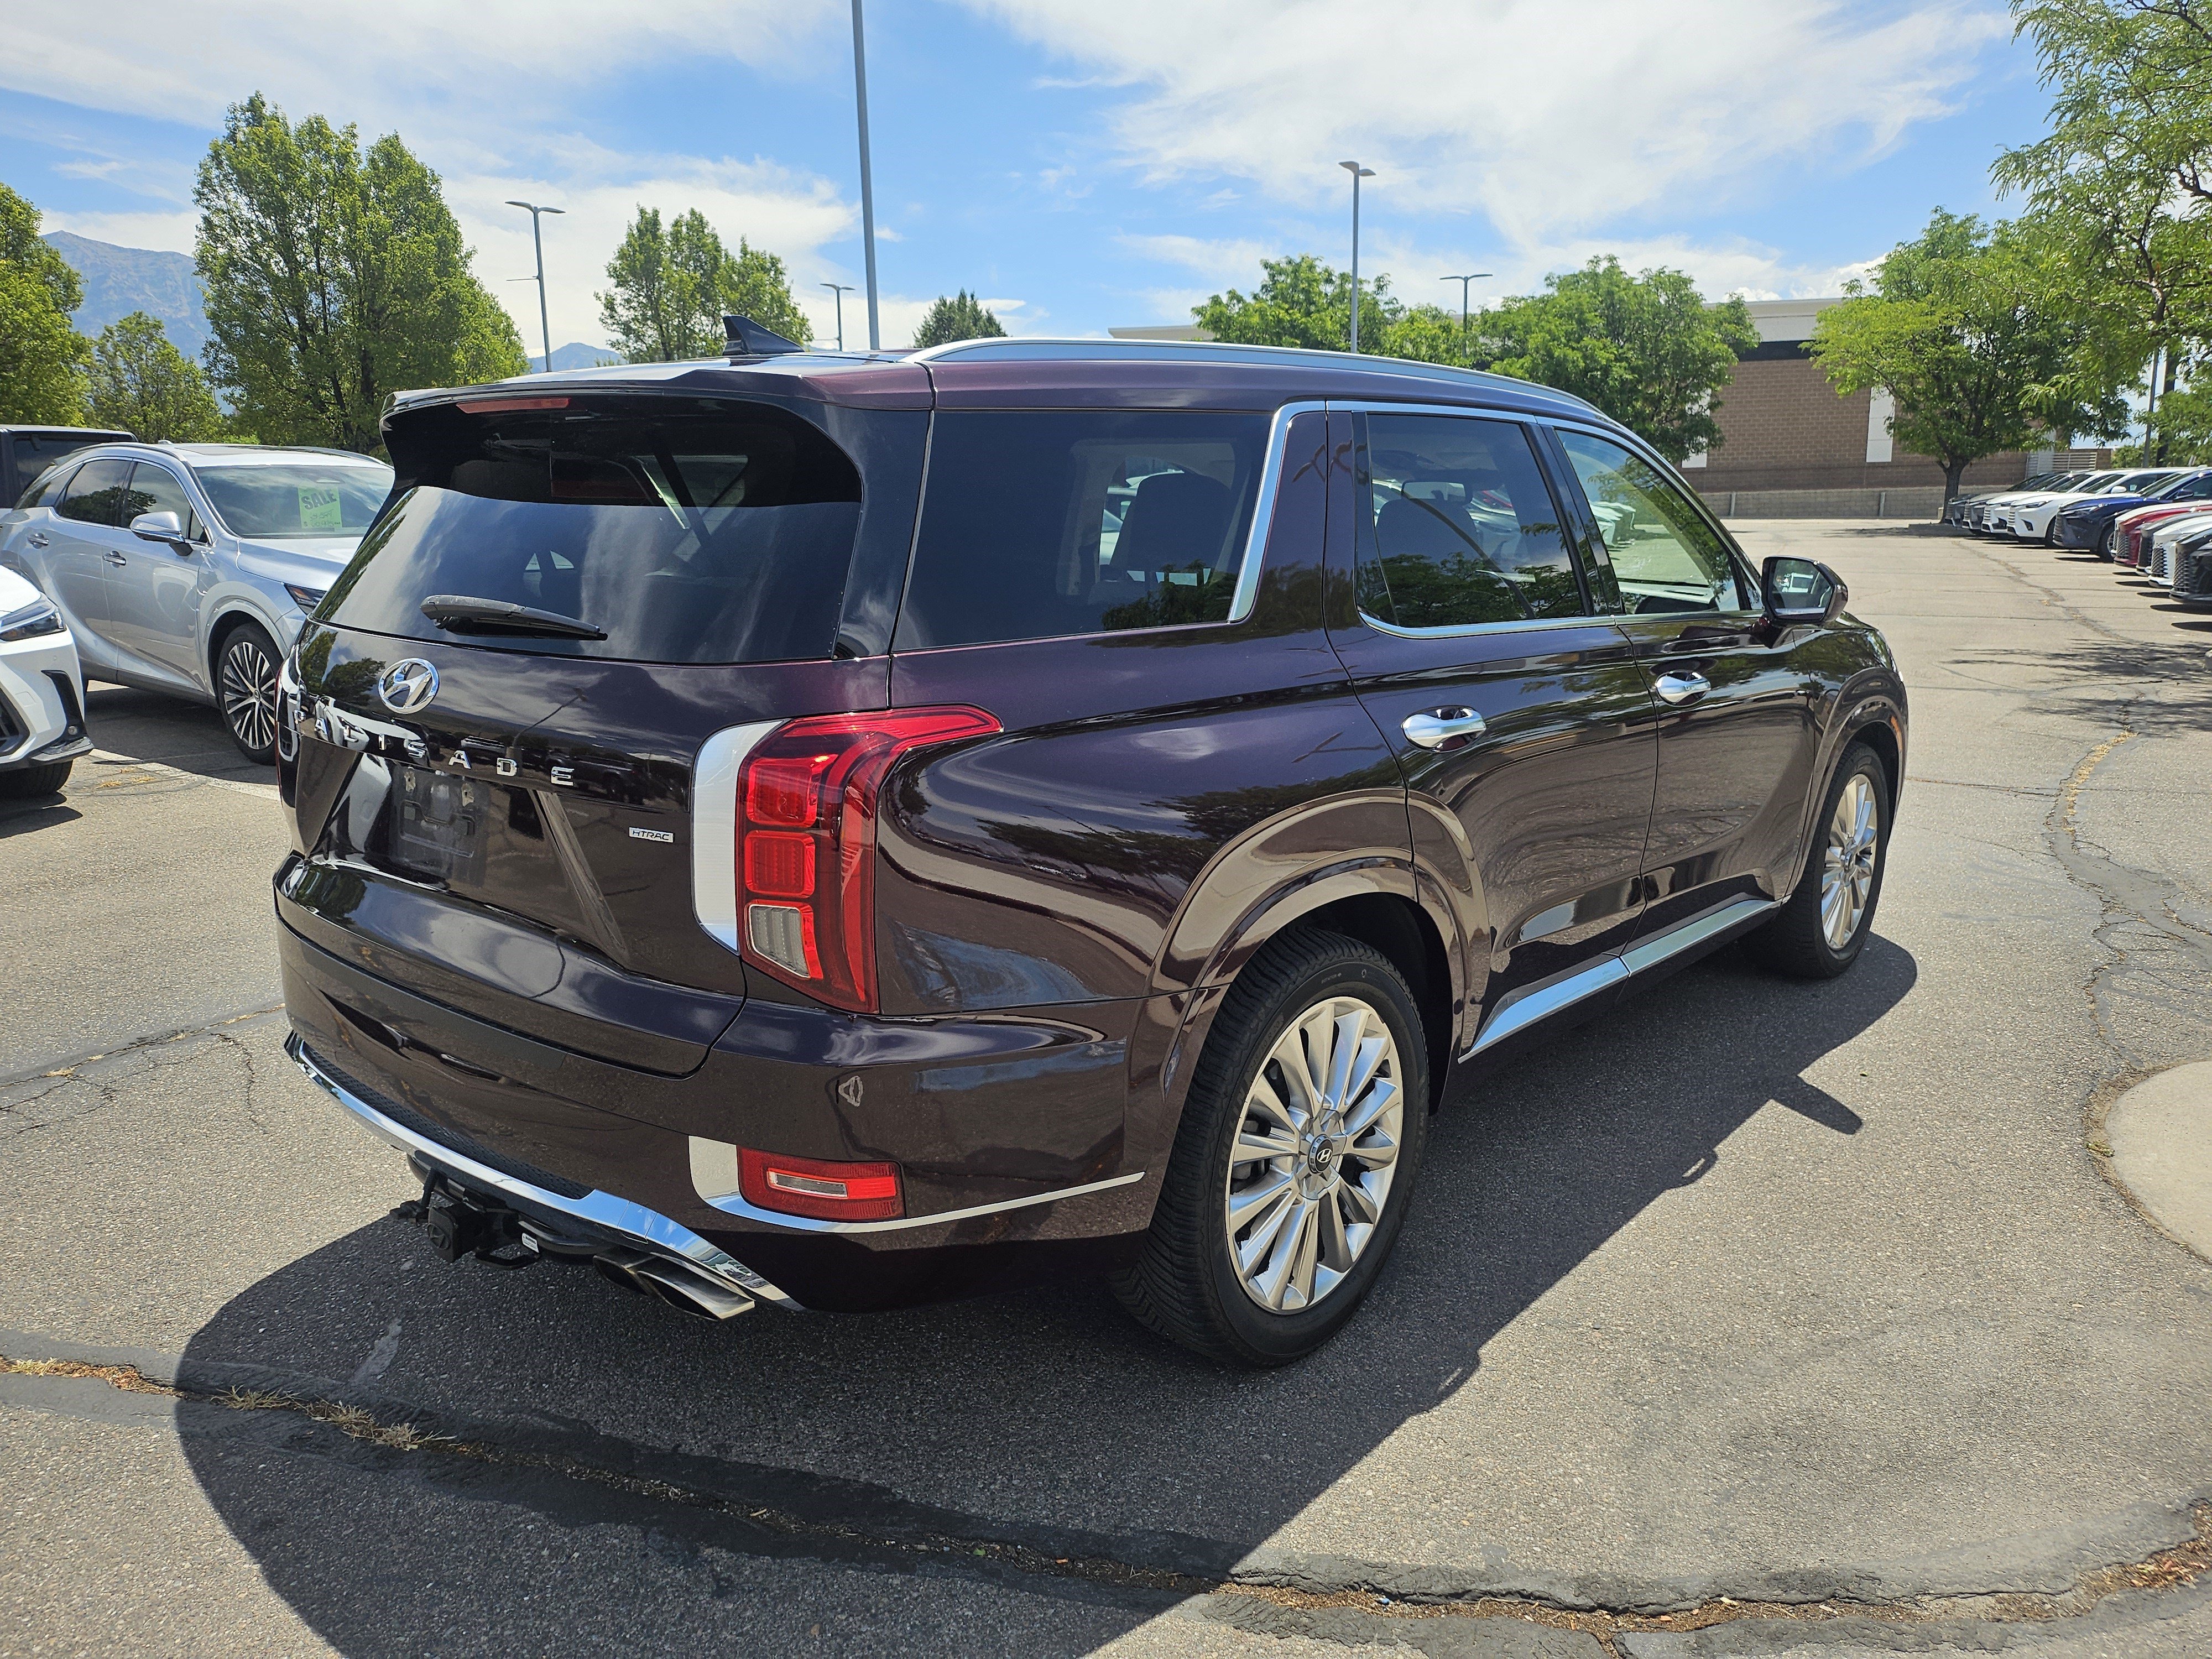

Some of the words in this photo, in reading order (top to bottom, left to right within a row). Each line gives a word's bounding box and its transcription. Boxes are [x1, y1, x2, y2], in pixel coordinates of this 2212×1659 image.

[301, 489, 337, 510] SALE
[294, 709, 575, 786] PALISADE
[632, 830, 670, 841] HTRAC
